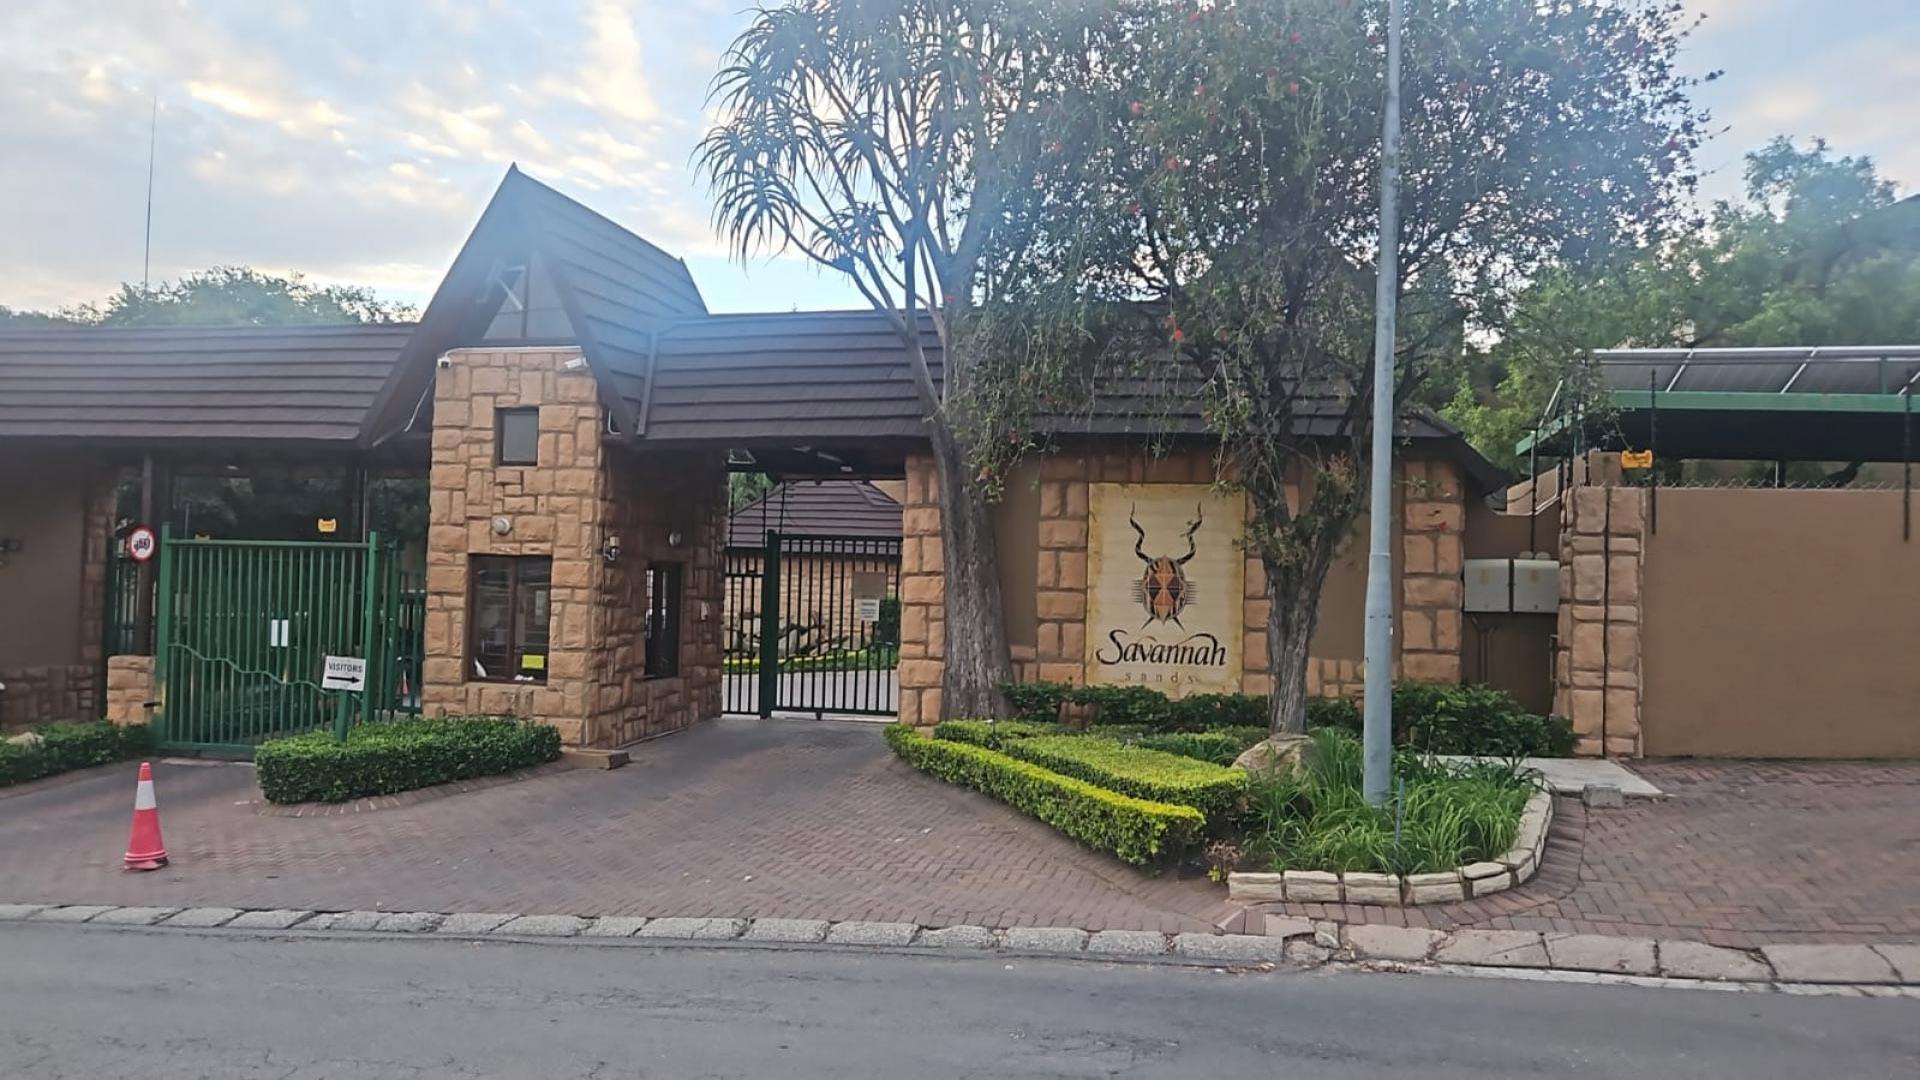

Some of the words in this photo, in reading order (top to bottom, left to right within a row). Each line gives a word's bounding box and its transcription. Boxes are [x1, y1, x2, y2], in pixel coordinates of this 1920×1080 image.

[1096, 629, 1226, 667] Savannah
[328, 662, 363, 673] VISITORS
[1124, 671, 1195, 684] sands
